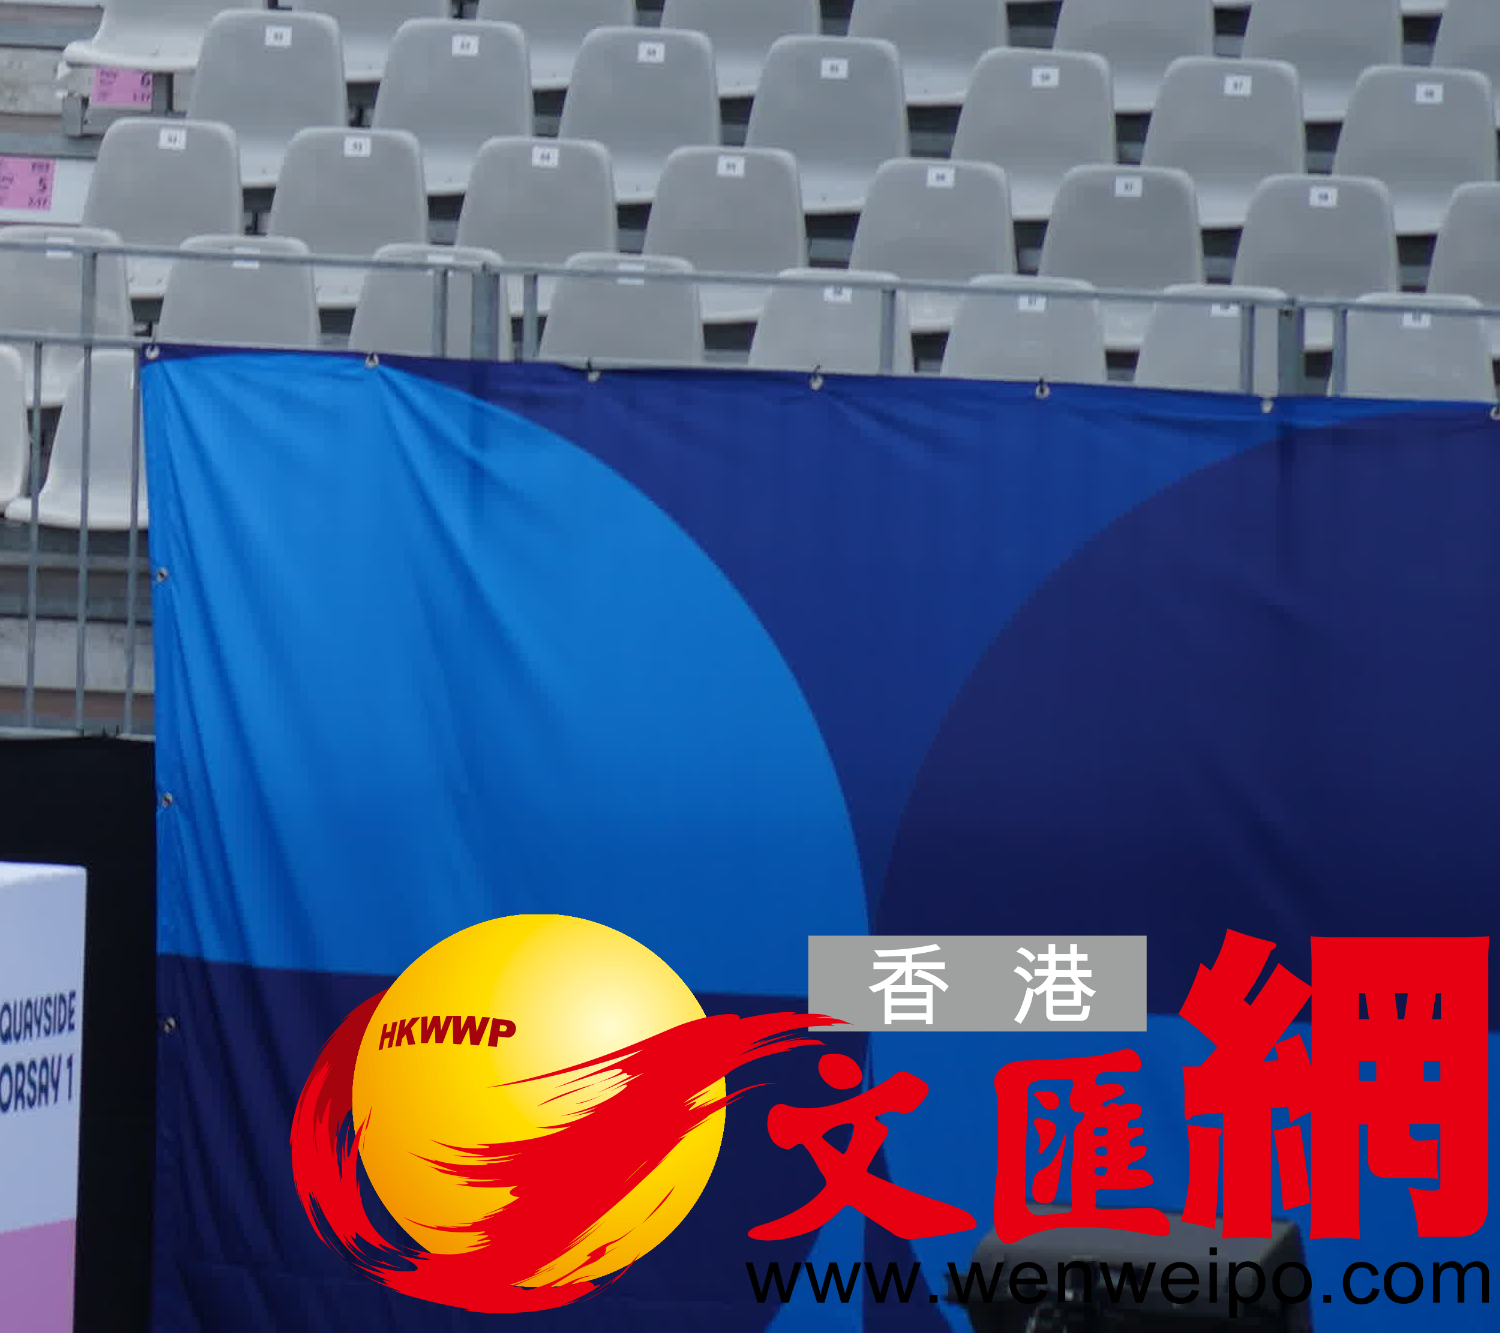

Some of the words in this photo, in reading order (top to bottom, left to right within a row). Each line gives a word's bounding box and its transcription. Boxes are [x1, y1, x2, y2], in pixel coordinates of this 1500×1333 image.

[38, 177, 48, 193] 5
[0, 989, 77, 1045] QUAYSIDE
[66, 1052, 75, 1102] 1
